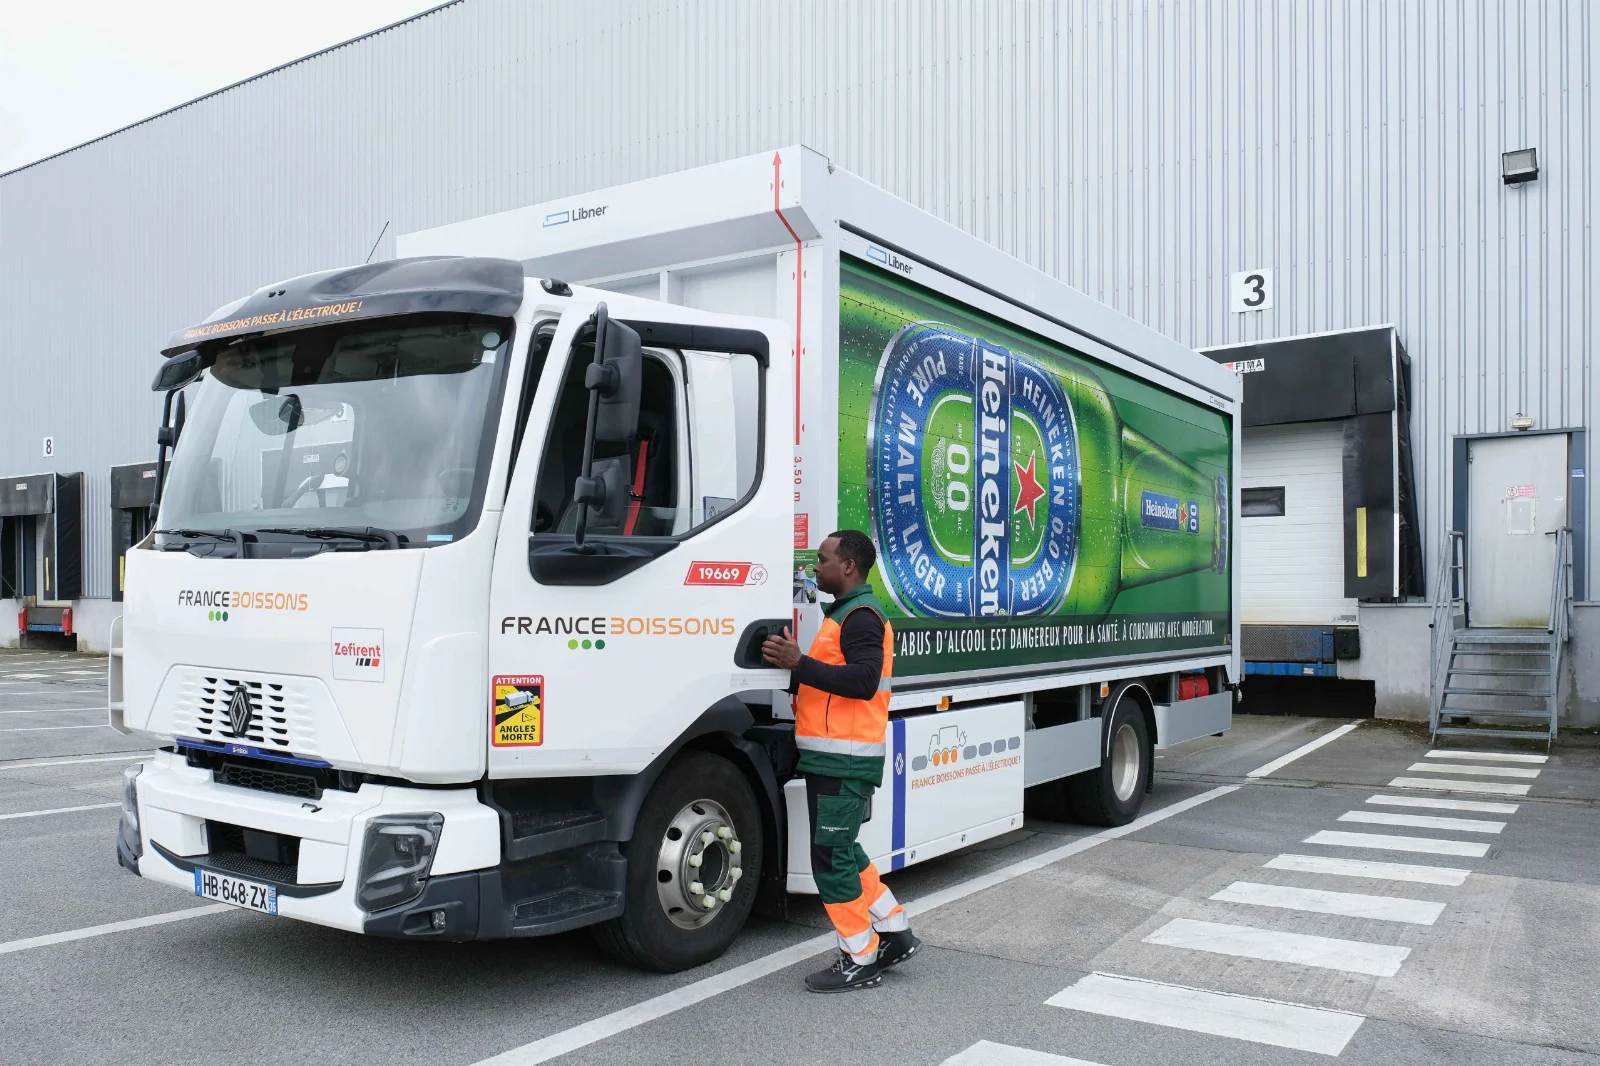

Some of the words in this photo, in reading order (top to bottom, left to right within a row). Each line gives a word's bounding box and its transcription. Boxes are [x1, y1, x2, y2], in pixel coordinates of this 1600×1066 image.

[572, 205, 607, 221] Libner
[888, 253, 914, 274] Libner
[1243, 274, 1265, 306] 3
[184, 325, 212, 340] FRANCE
[212, 318, 251, 334] BOISSONS
[251, 314, 277, 327] PASSE
[279, 310, 286, 321] À
[288, 302, 355, 320] L'ÉLECTRIQUE
[895, 342, 918, 376] UNIQUE
[1235, 360, 1263, 370] FIMA
[906, 350, 947, 408] PURE
[886, 378, 900, 425] RECIPE
[46, 439, 52, 455] 8
[1022, 376, 1065, 506] HEINEKEN
[794, 456, 802, 485] 3.50
[897, 411, 918, 507] MALT
[946, 443, 971, 512] 0.0
[981, 348, 1006, 617] Heineken
[794, 491, 801, 502] m
[1145, 500, 1178, 520] Heineken
[883, 481, 897, 553] HEINEKEN
[1048, 516, 1064, 559] 0.0
[698, 567, 740, 580] 19669
[902, 522, 946, 599] LAGER
[1020, 557, 1054, 601] BEER
[334, 642, 381, 657] Zefirent
[892, 630, 931, 657] 'ABUS
[936, 629, 986, 654] D'ALCOOL
[990, 628, 1007, 651] EST
[1010, 625, 1060, 650] DANGEREUX
[1063, 625, 1083, 645] POUR
[1086, 624, 1095, 644] LA
[1097, 619, 1120, 643] SANTÉ.
[1122, 619, 1127, 641] À
[1129, 621, 1165, 641] CONSOMMER
[1167, 621, 1180, 638] AVEC
[496, 676, 541, 684] ATTENTION
[499, 725, 536, 733] ANGLES
[501, 733, 534, 741] MORTS
[911, 775, 935, 790] FRANCE
[936, 768, 965, 784] BOISSONS
[965, 764, 981, 777] PASSE
[981, 761, 986, 772] À
[268, 901, 277, 912] 35
